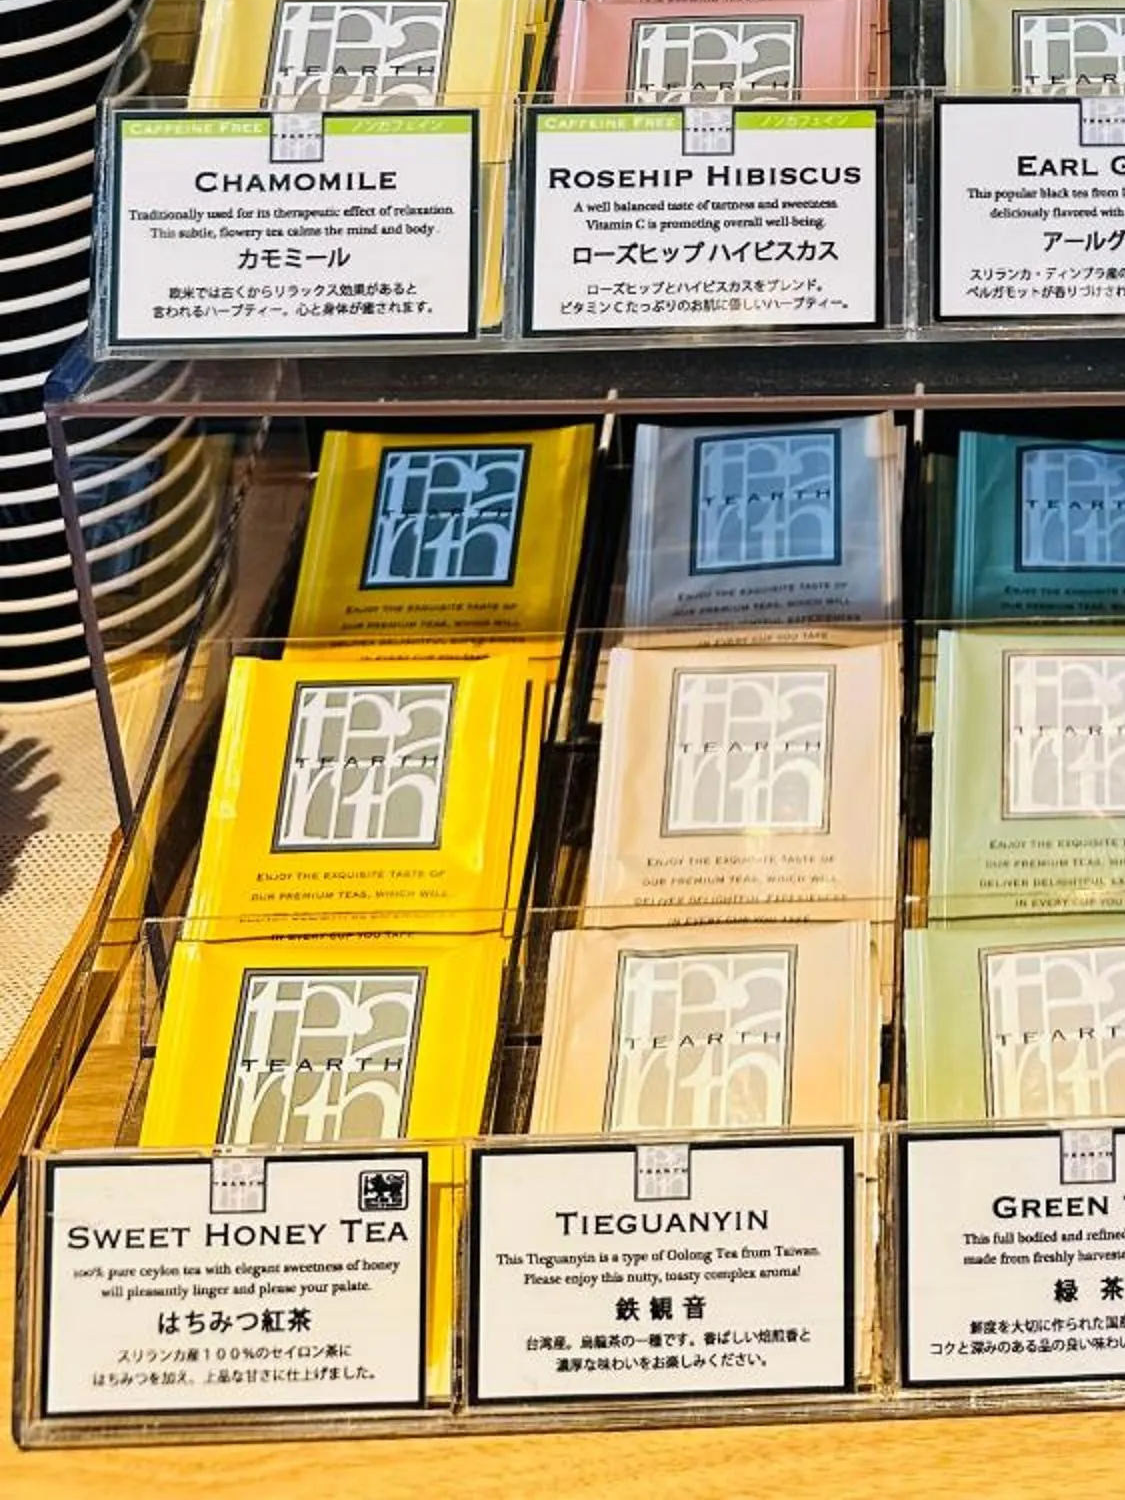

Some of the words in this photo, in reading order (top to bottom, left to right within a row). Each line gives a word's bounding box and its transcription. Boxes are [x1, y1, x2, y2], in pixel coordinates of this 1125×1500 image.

[279, 65, 436, 77] TEARTH
[640, 81, 790, 92] TEARTH
[548, 166, 693, 189] ROSEHIP
[706, 165, 861, 186] HIBISCUS
[1016, 155, 1098, 177] EARL
[194, 170, 397, 193] CHAMOMILE
[237, 246, 351, 270] カモミール
[572, 239, 838, 265] ローズヒップハイビスカス
[295, 755, 439, 769] TEARTH
[625, 1031, 781, 1050] TEARTH
[241, 1057, 403, 1073] TEARTH
[991, 1193, 1109, 1219] GREEN
[555, 1208, 768, 1236] TIEGUANYIN
[67, 1223, 190, 1251] SWEET
[204, 1220, 326, 1247] HONEY
[339, 1218, 408, 1243] TEA
[1053, 1276, 1124, 1303] 緑茶
[615, 1294, 706, 1321] 鉄観音
[157, 1307, 311, 1335] はちみつ紅茶
